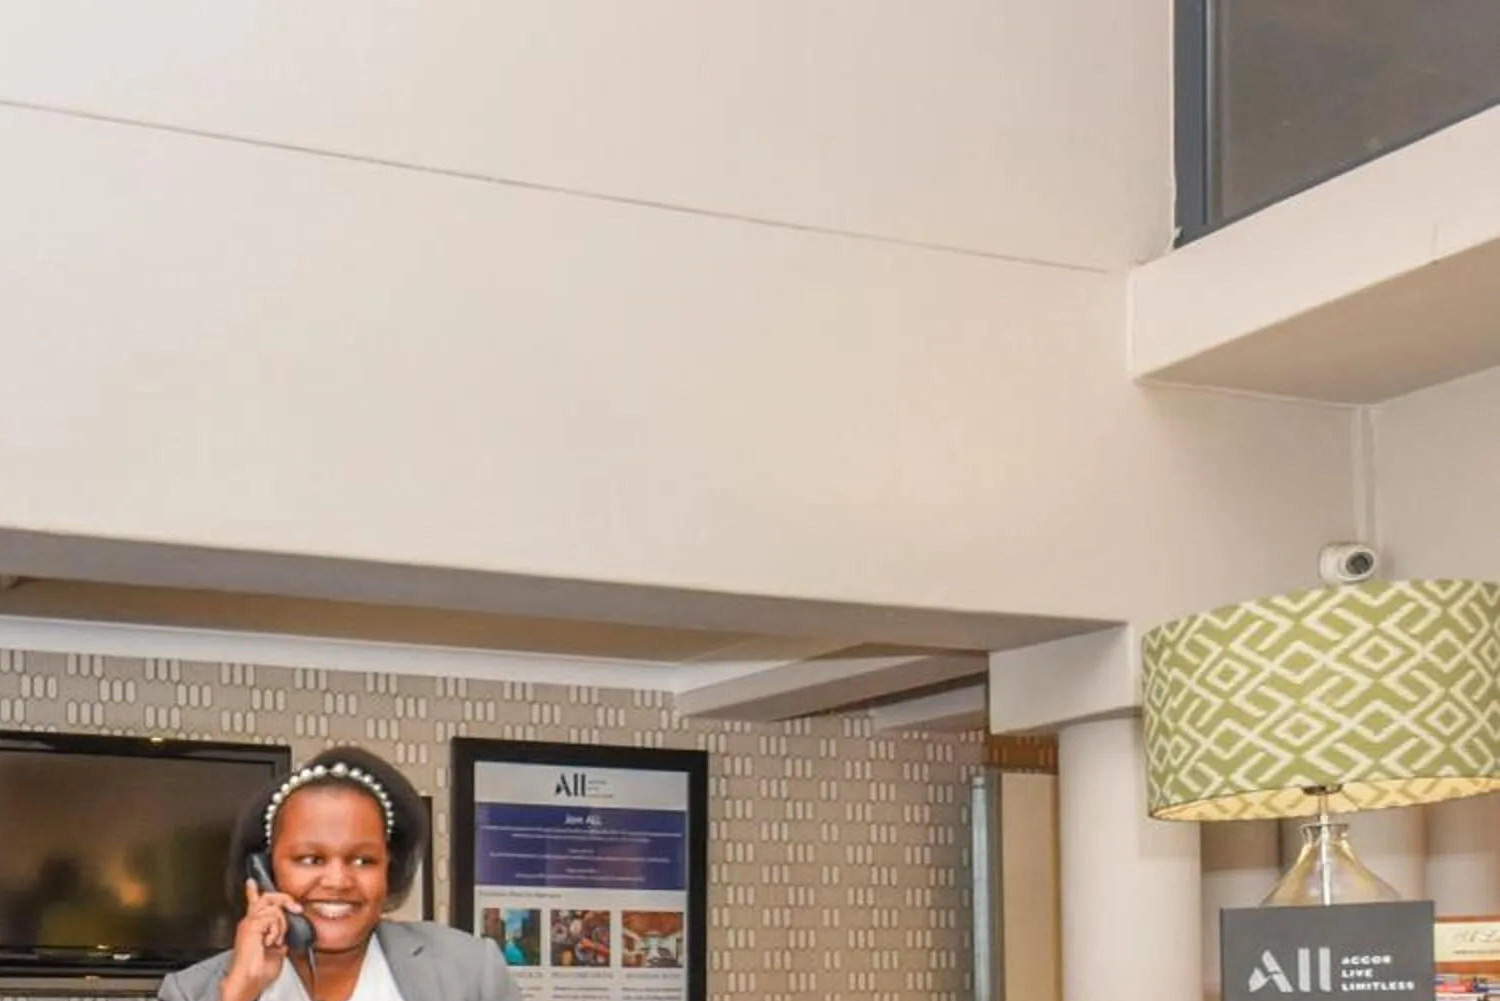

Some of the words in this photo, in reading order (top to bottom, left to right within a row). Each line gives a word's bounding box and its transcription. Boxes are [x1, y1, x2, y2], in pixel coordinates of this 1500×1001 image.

[1341, 955, 1392, 966] ACCOR
[1341, 968, 1373, 979] LIVE
[1341, 981, 1415, 992] LIMITLESS
